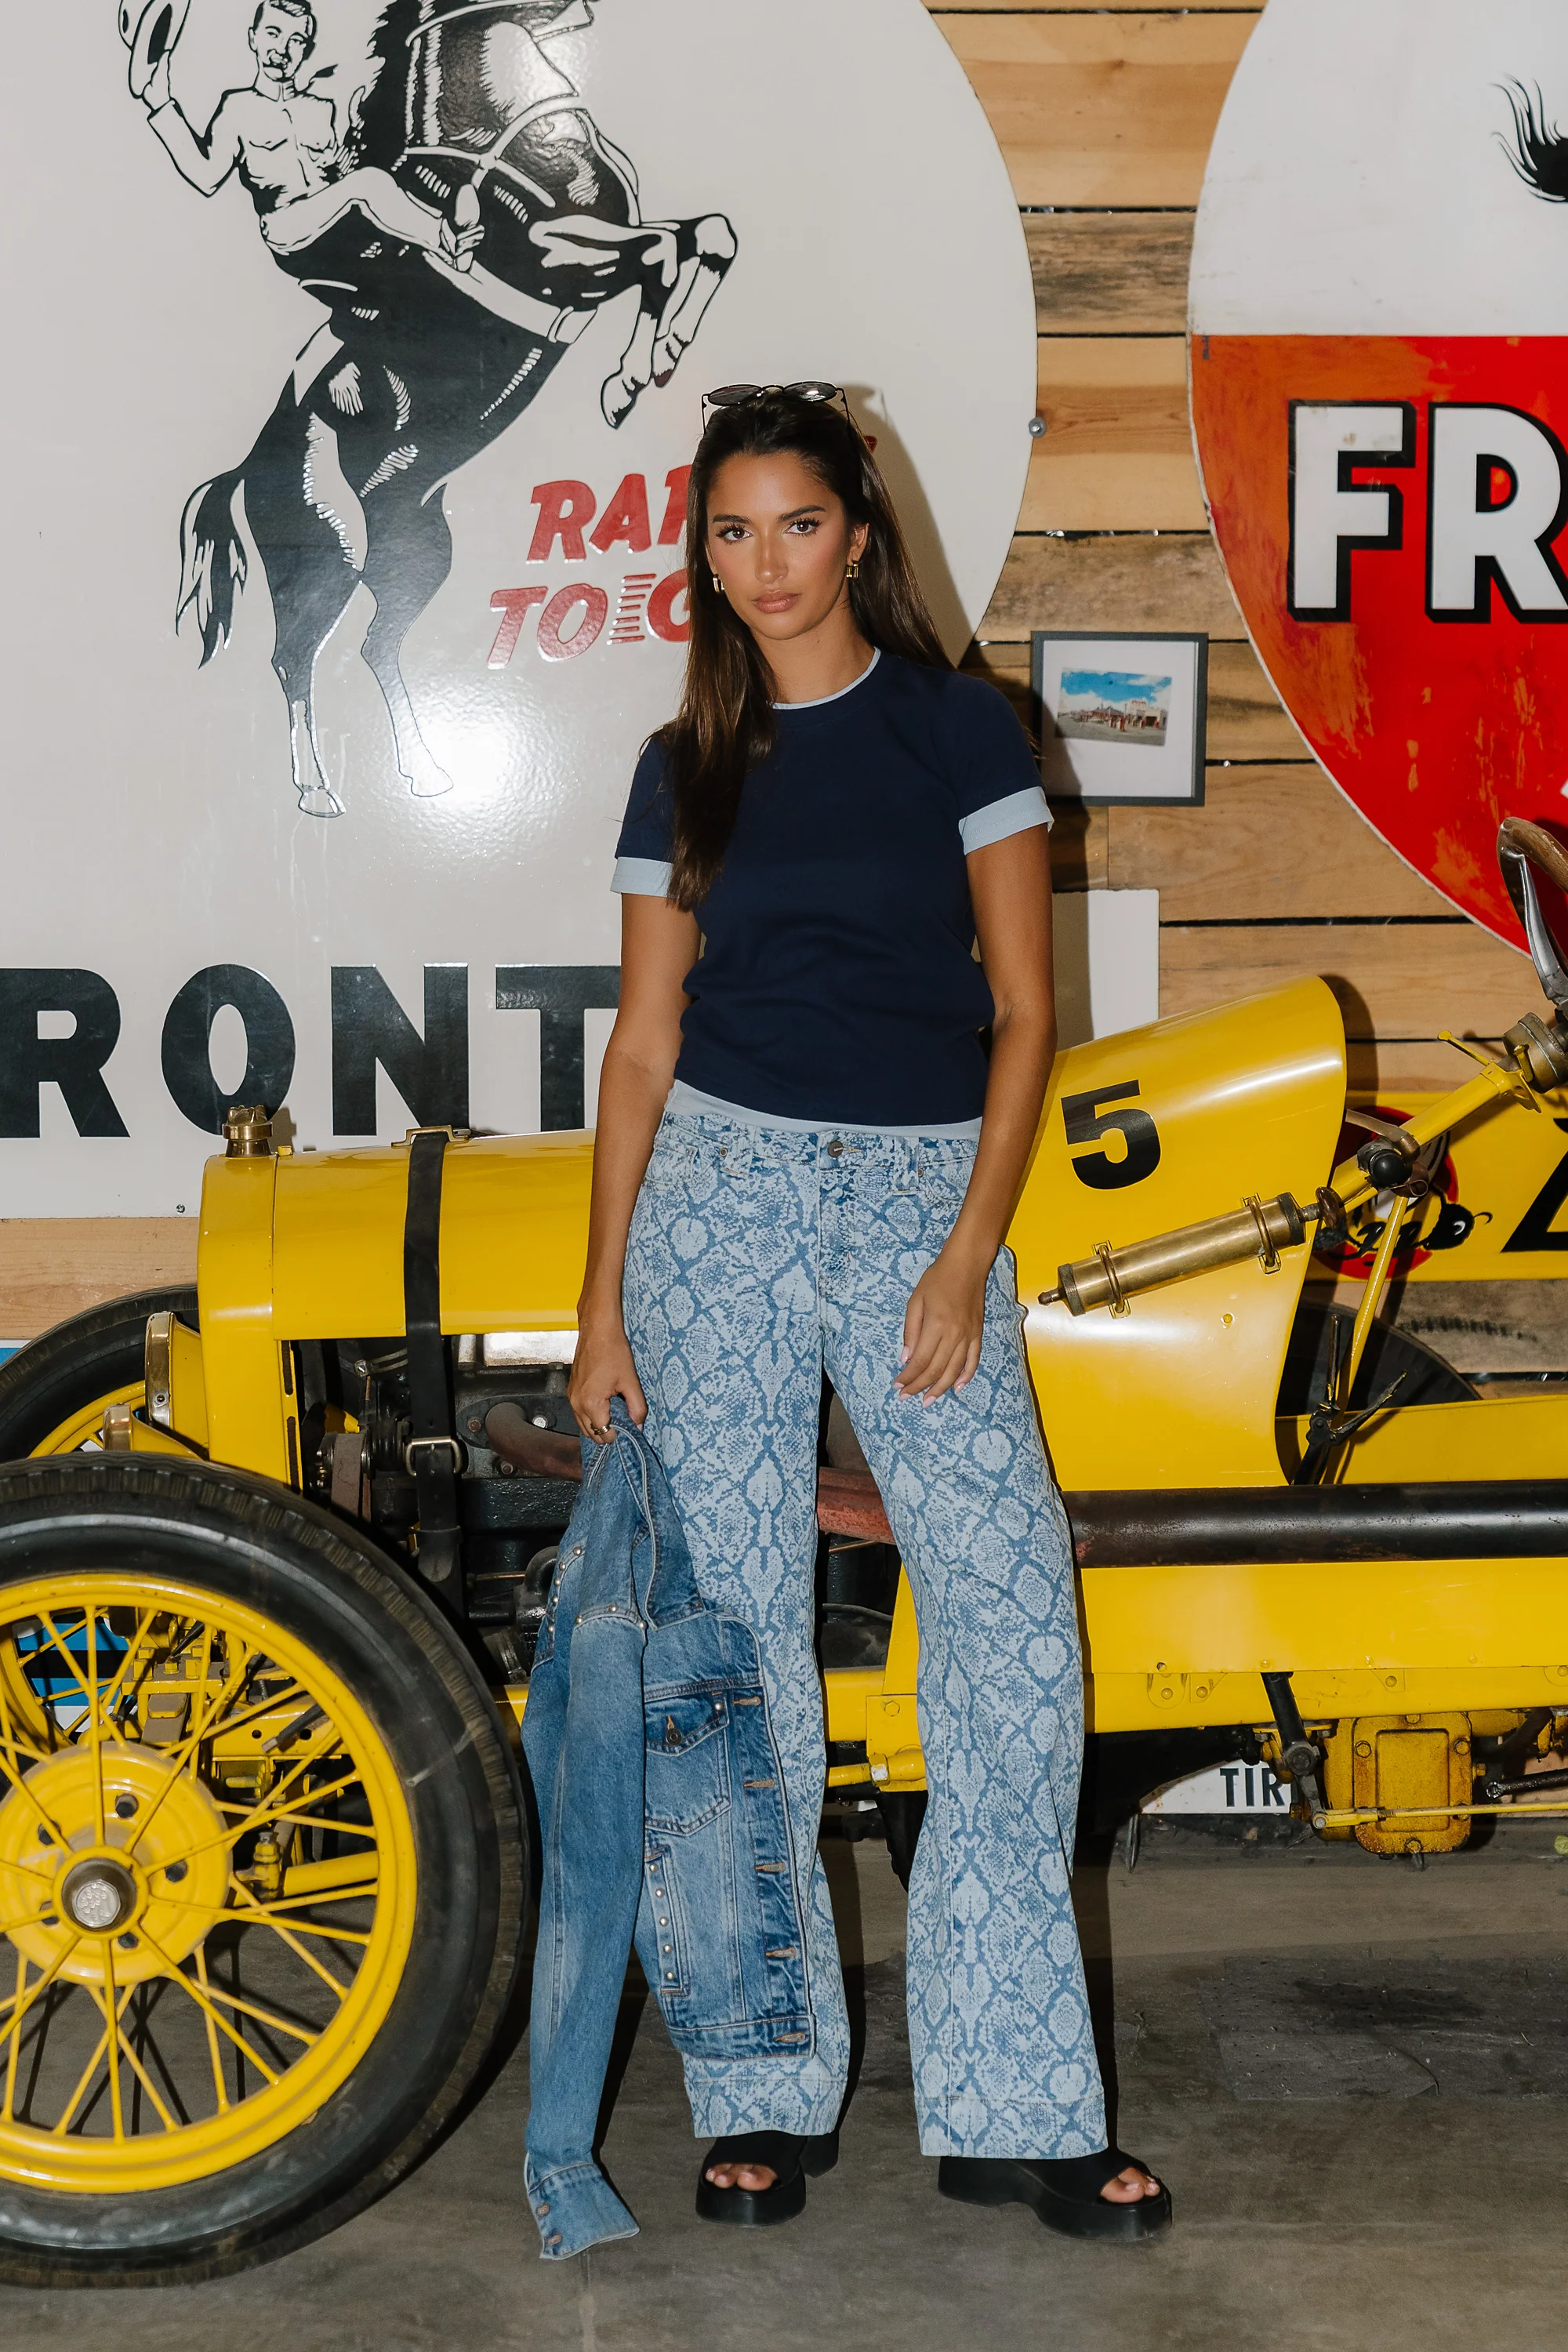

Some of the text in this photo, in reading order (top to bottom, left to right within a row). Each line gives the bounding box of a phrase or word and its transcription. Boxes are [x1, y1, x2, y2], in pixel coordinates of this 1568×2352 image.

[1287, 399, 1568, 623] FR
[487, 583, 608, 670] TO
[0, 963, 624, 1138] RONT
[1061, 1079, 1162, 1190] 5
[1219, 1767, 1298, 1808] TIR
